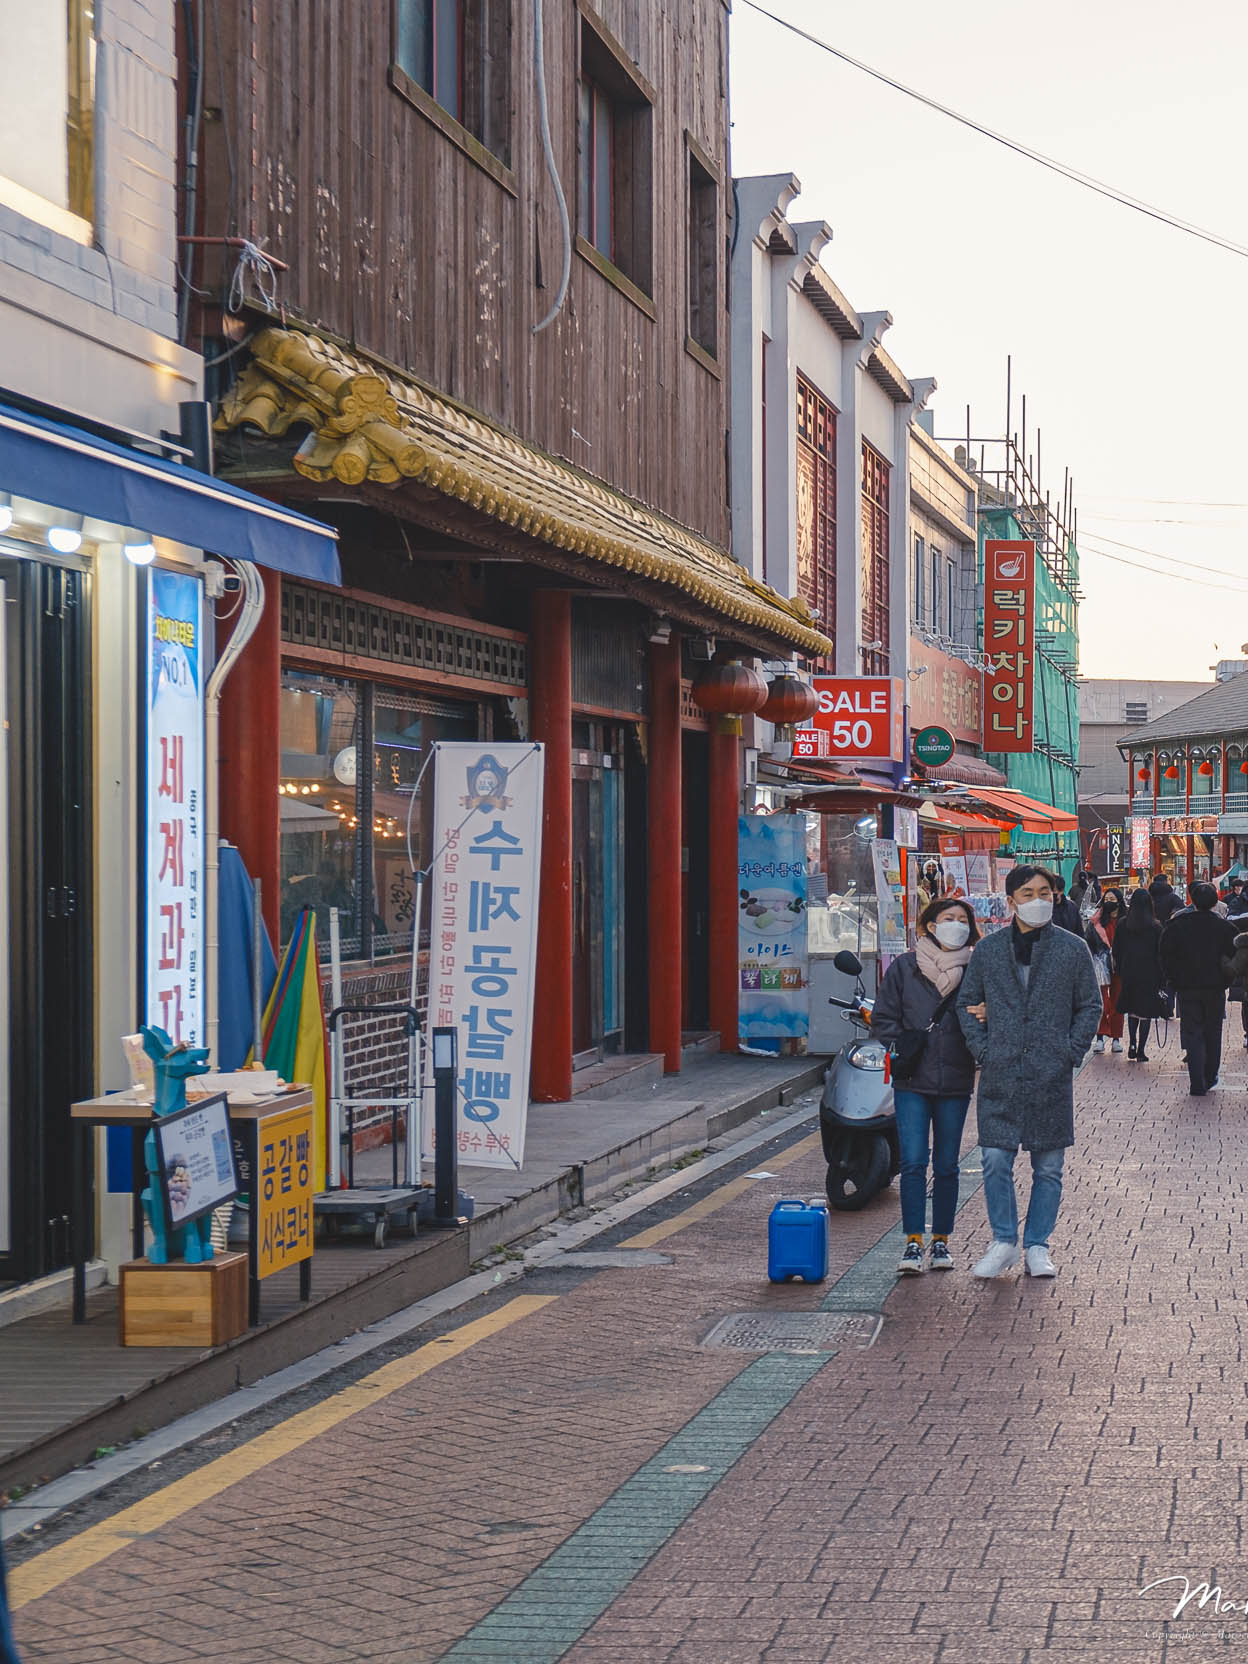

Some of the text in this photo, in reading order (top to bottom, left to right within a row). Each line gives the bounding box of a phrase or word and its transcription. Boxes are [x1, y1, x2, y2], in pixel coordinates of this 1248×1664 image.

[992, 588, 1030, 740] 럭키차이나
[818, 690, 887, 714] SALE
[795, 734, 818, 742] SALE
[799, 743, 813, 754] 50
[832, 720, 873, 749] 50
[158, 735, 186, 1047] 세계과자
[262, 1129, 310, 1201] 공갈빵
[262, 1198, 310, 1264] 시식코너
